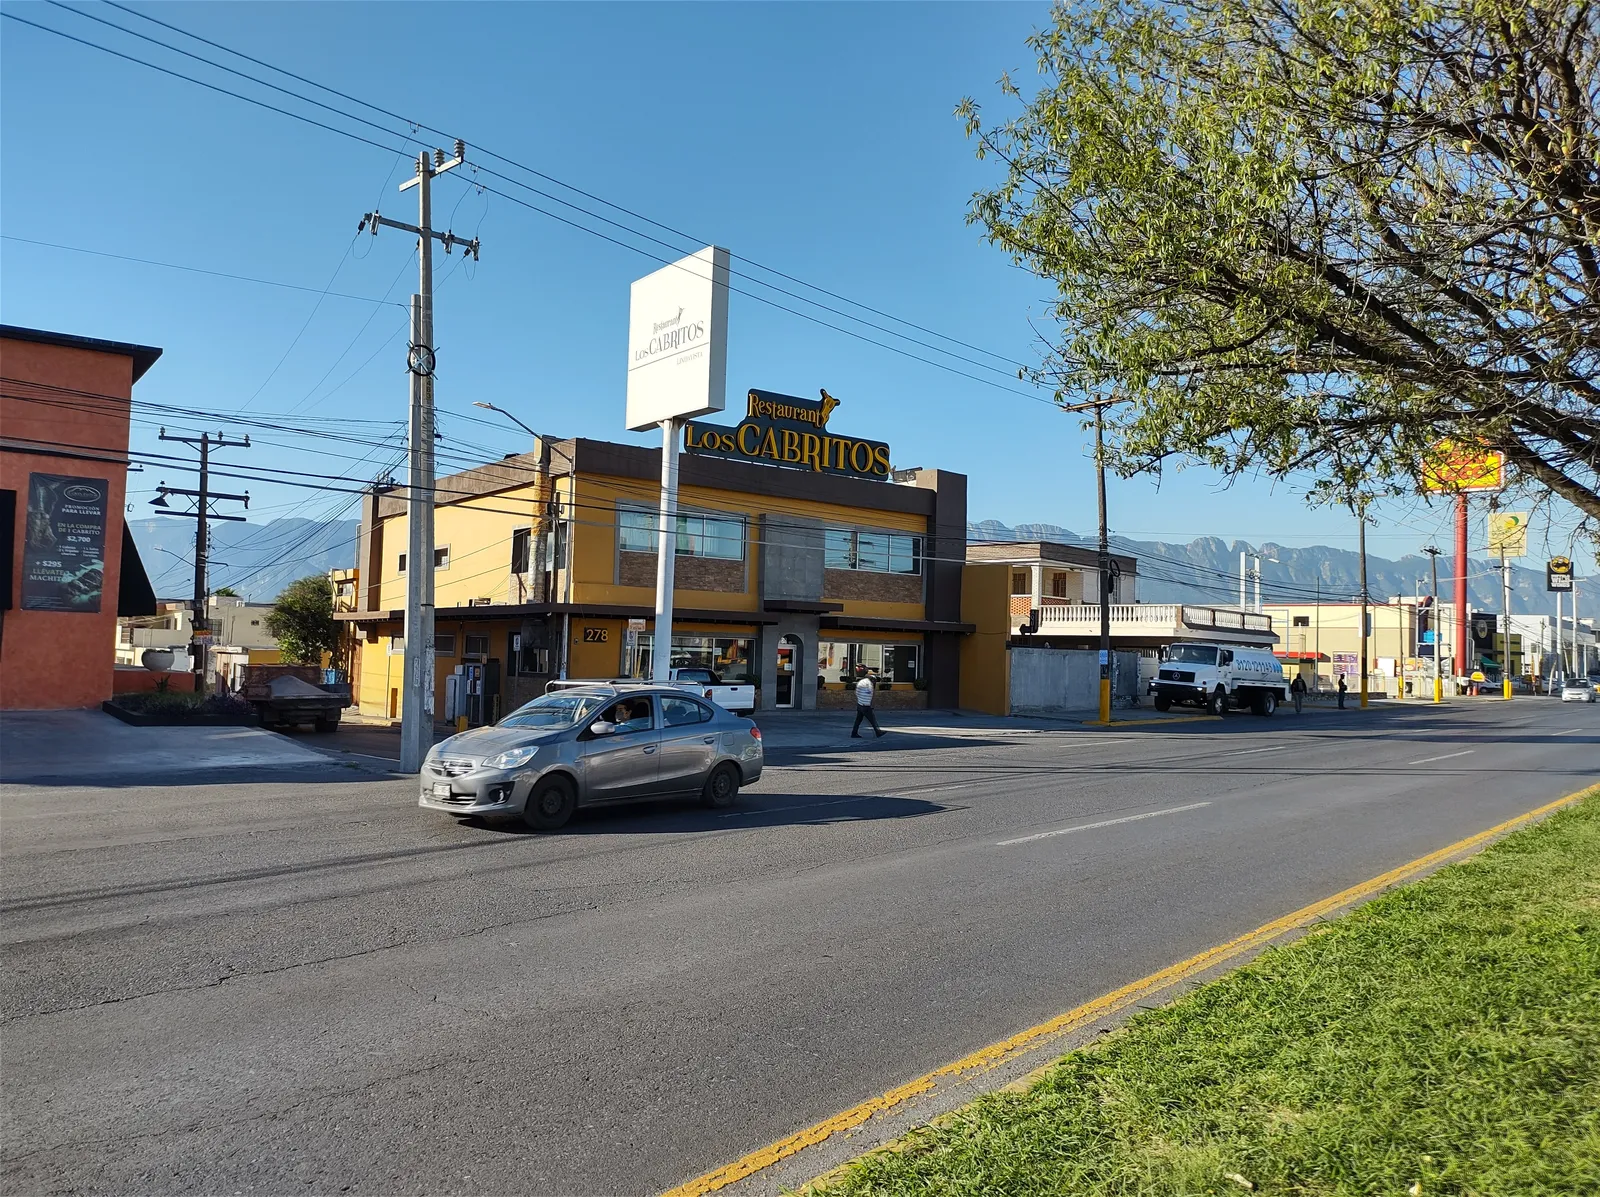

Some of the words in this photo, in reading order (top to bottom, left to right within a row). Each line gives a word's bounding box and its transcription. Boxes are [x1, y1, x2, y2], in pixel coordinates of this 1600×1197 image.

[653, 315, 681, 335] Restaurant
[649, 320, 704, 355] CABRITOS
[748, 393, 824, 428] Restaurant
[737, 423, 891, 475] CABRITOS
[71, 528, 101, 536] CABRITO
[42, 560, 63, 568] $295
[586, 628, 608, 641] 278
